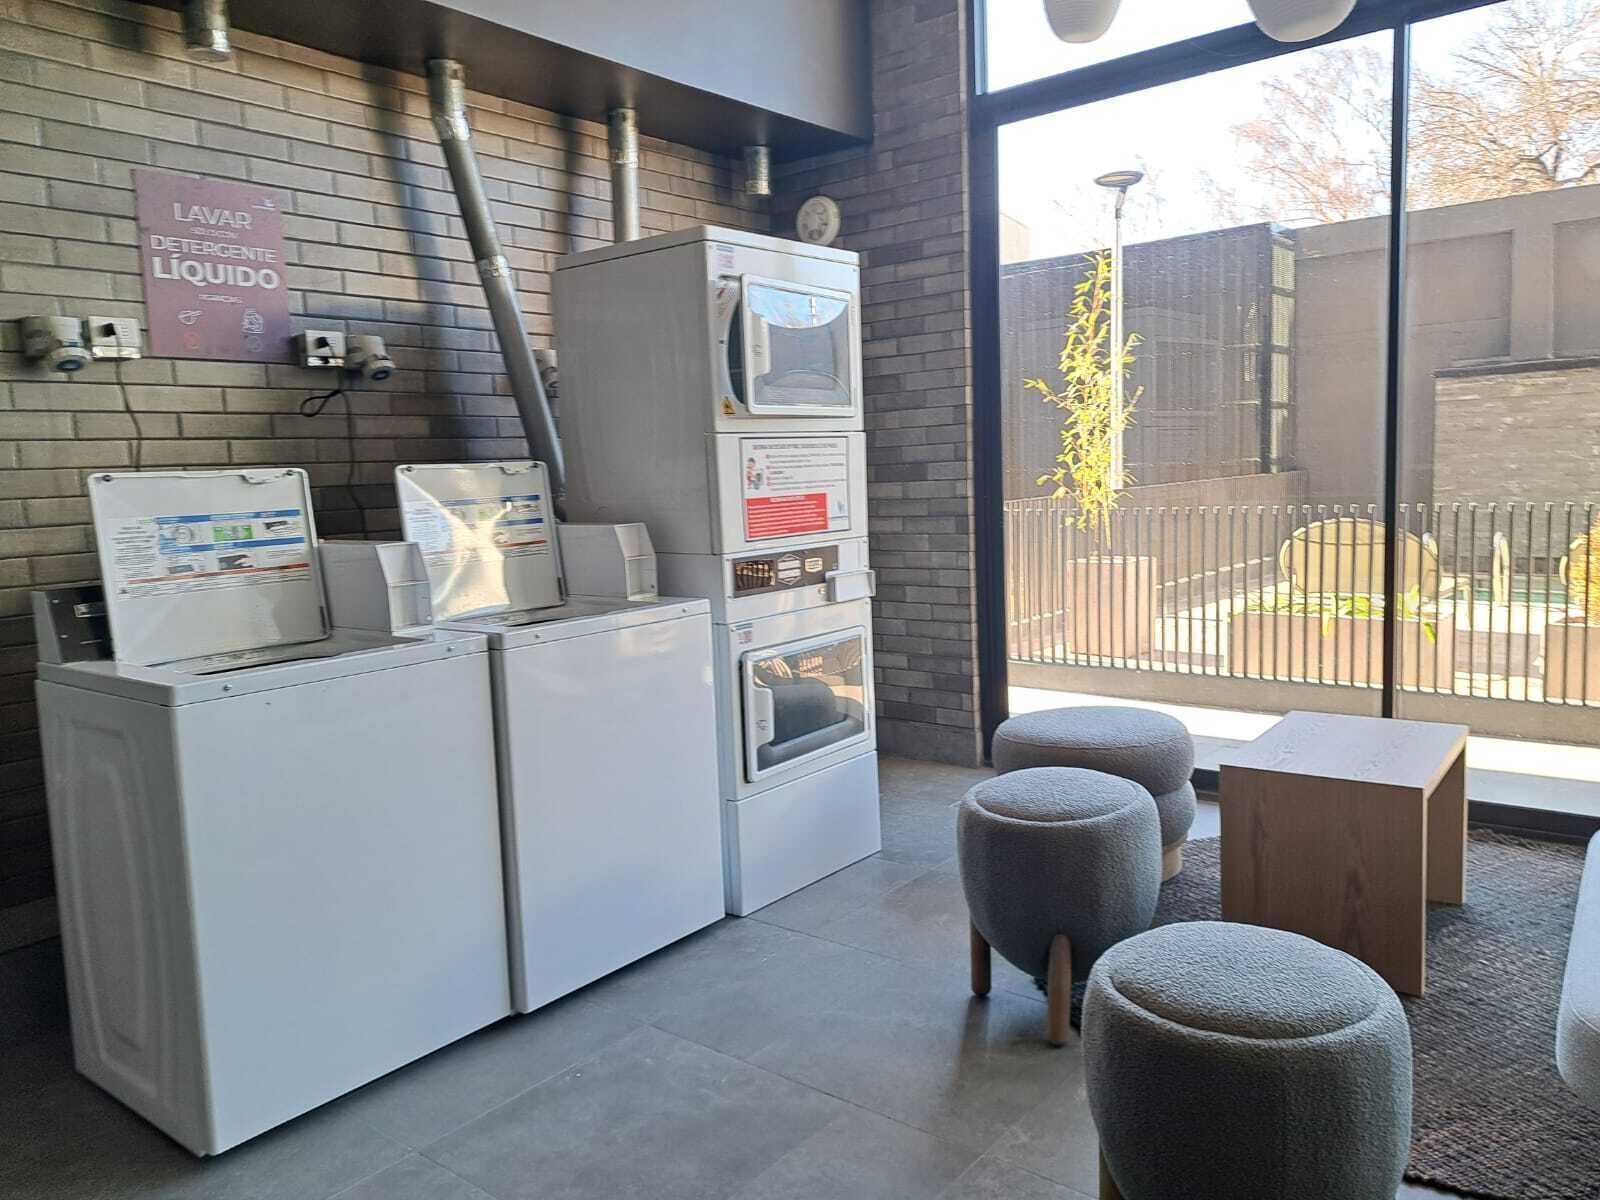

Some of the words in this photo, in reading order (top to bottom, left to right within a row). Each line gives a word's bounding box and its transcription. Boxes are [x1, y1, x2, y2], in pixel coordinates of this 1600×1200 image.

[173, 202, 252, 229] LAVAR
[151, 234, 278, 263] DETERGENTE
[152, 253, 280, 289] LÍQUIDO
